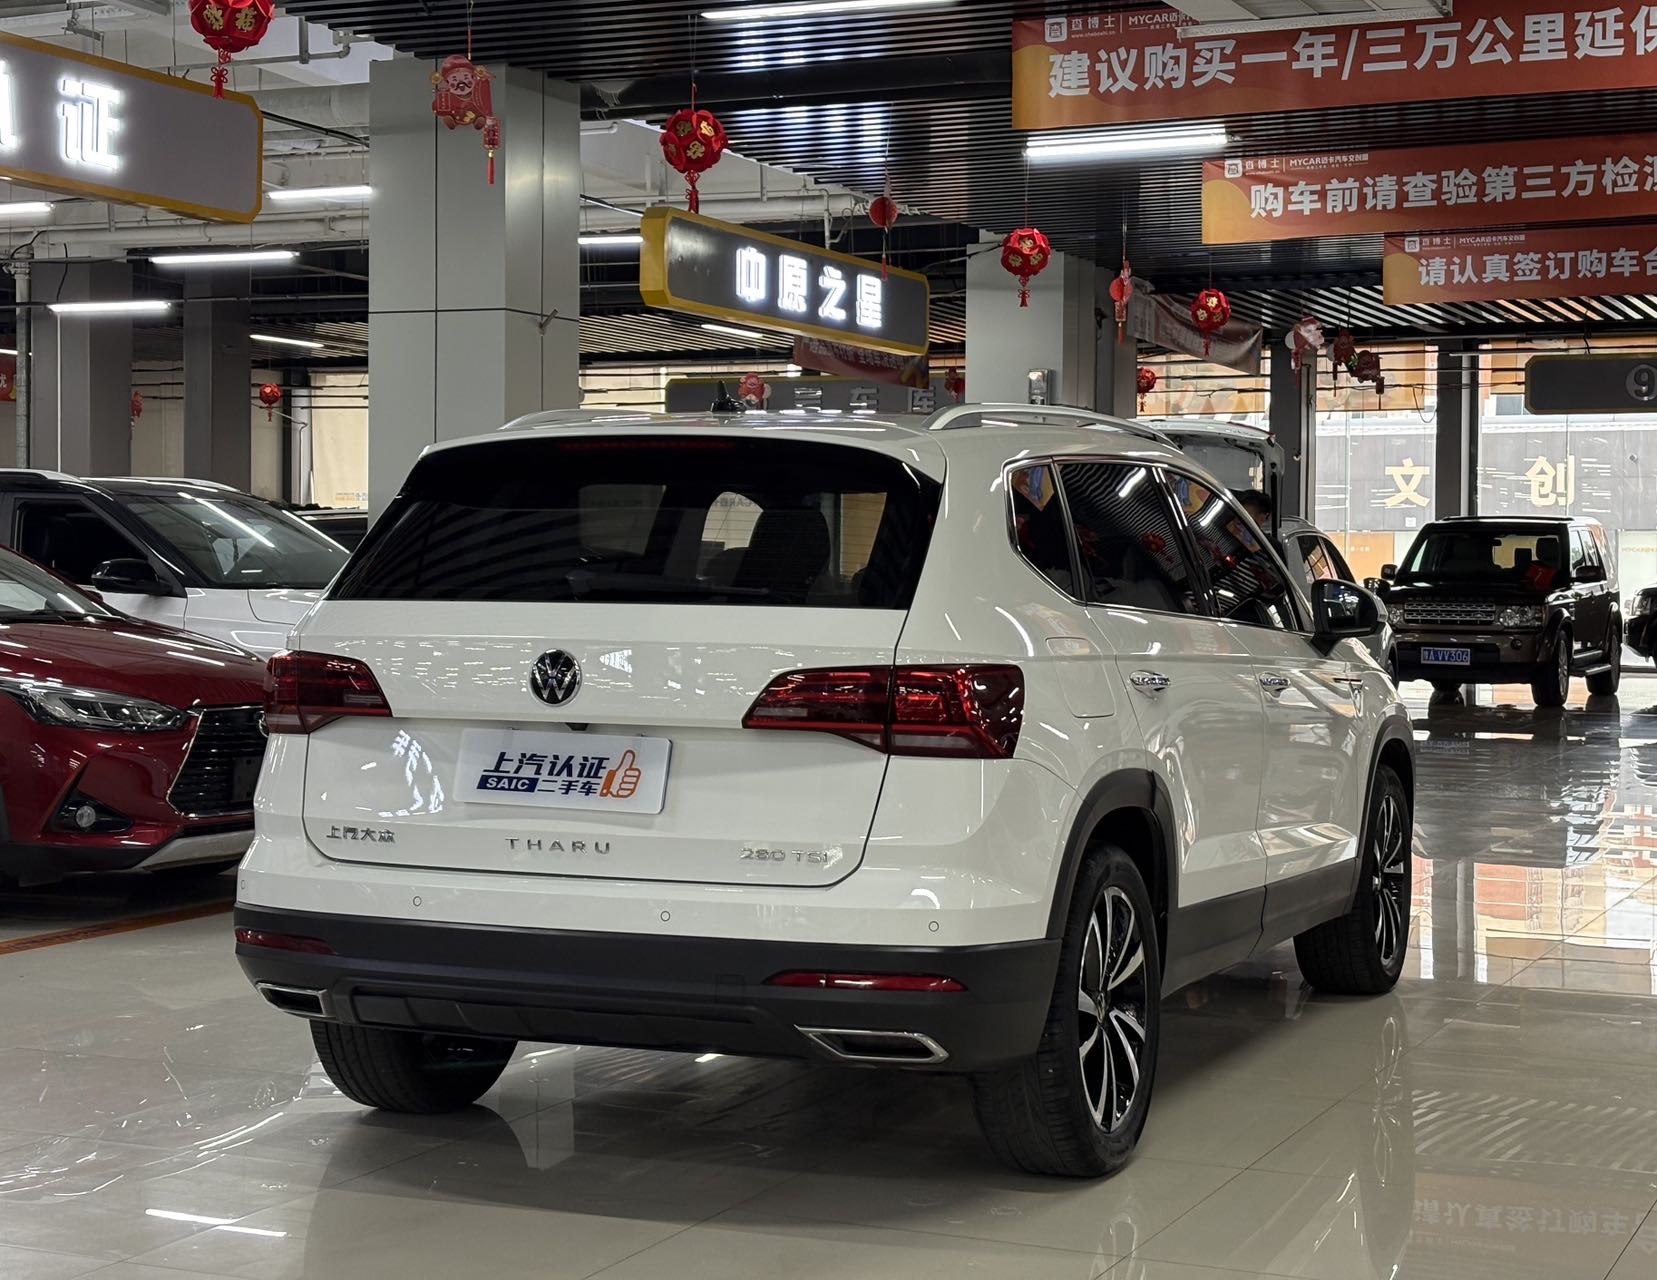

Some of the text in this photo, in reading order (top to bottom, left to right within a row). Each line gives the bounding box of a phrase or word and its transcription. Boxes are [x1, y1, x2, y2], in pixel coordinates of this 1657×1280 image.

[735, 246, 883, 328] 中原之星
[483, 751, 609, 779] 上汽认证
[486, 777, 600, 796] SAIC 二手车
[505, 838, 610, 854] THARU
[740, 848, 786, 862] 280
